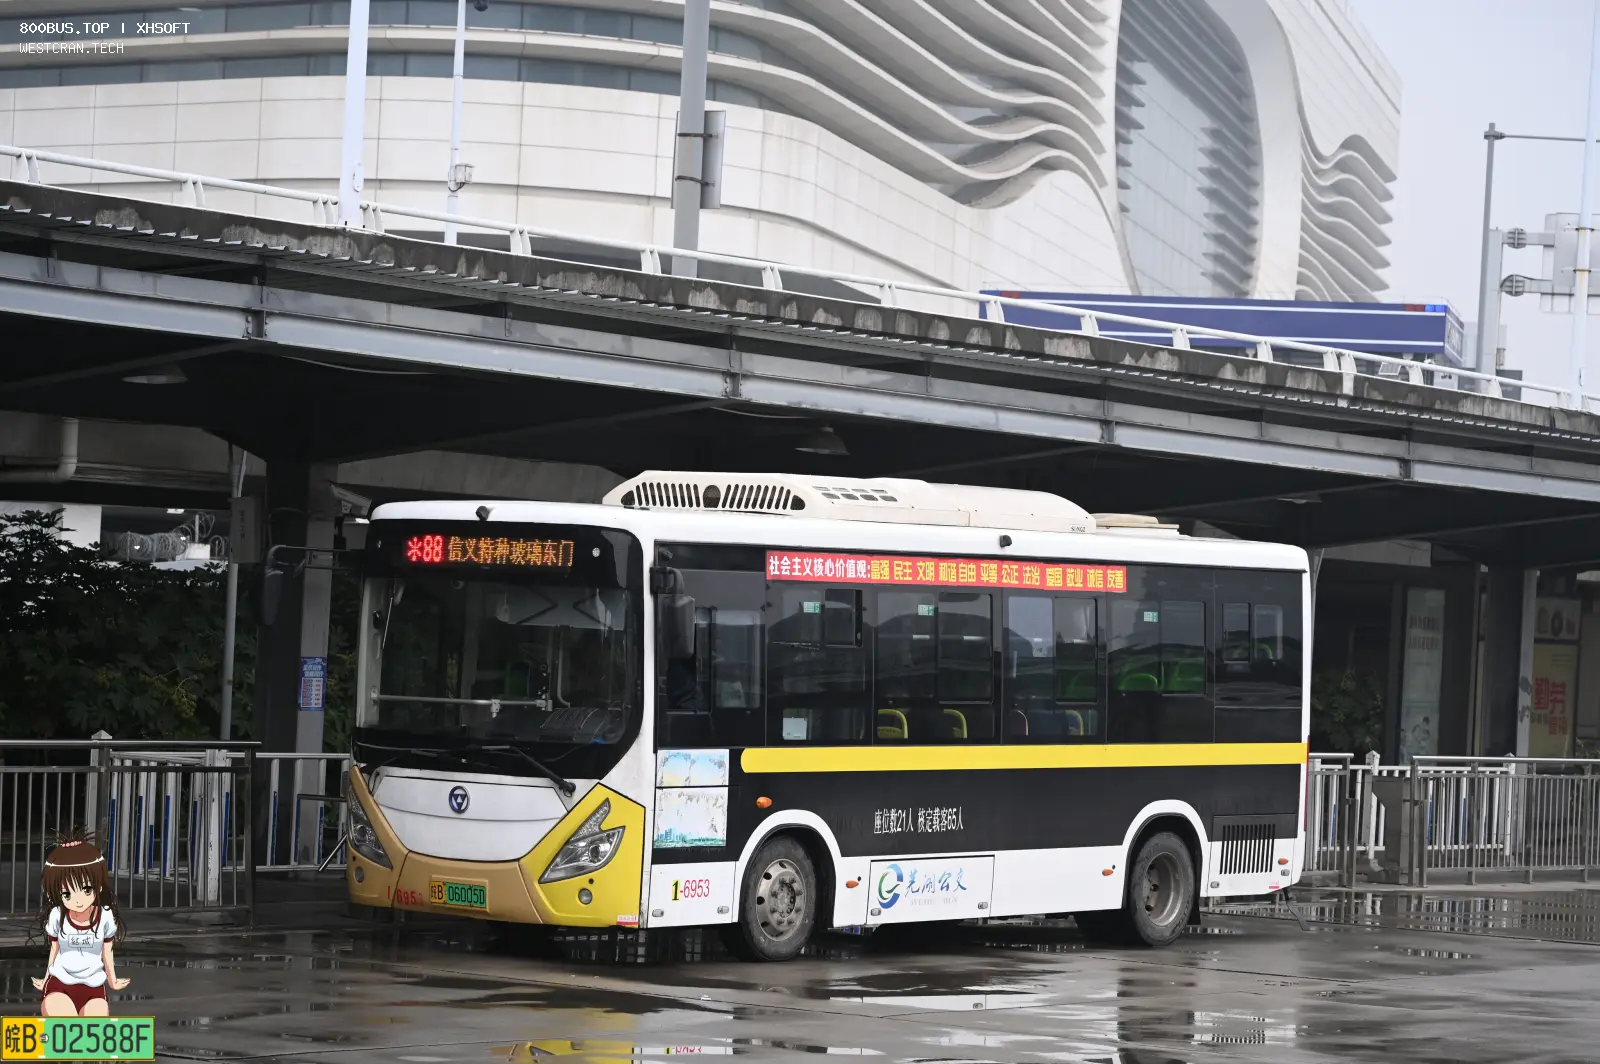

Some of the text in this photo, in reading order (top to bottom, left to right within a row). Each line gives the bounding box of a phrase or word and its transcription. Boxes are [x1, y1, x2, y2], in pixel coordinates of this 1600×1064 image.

[448, 536, 575, 567] 信义特种玻璃东门
[769, 555, 1124, 589] 社会主义核心价值观: 富强 民主 文明 和谐 自由 平等 公正 法治 爱国 敬业 诚信 友善
[873, 806, 964, 834] 座位数21人 核定载客65人
[447, 885, 486, 905] 06005D
[672, 879, 711, 901] 1-6953
